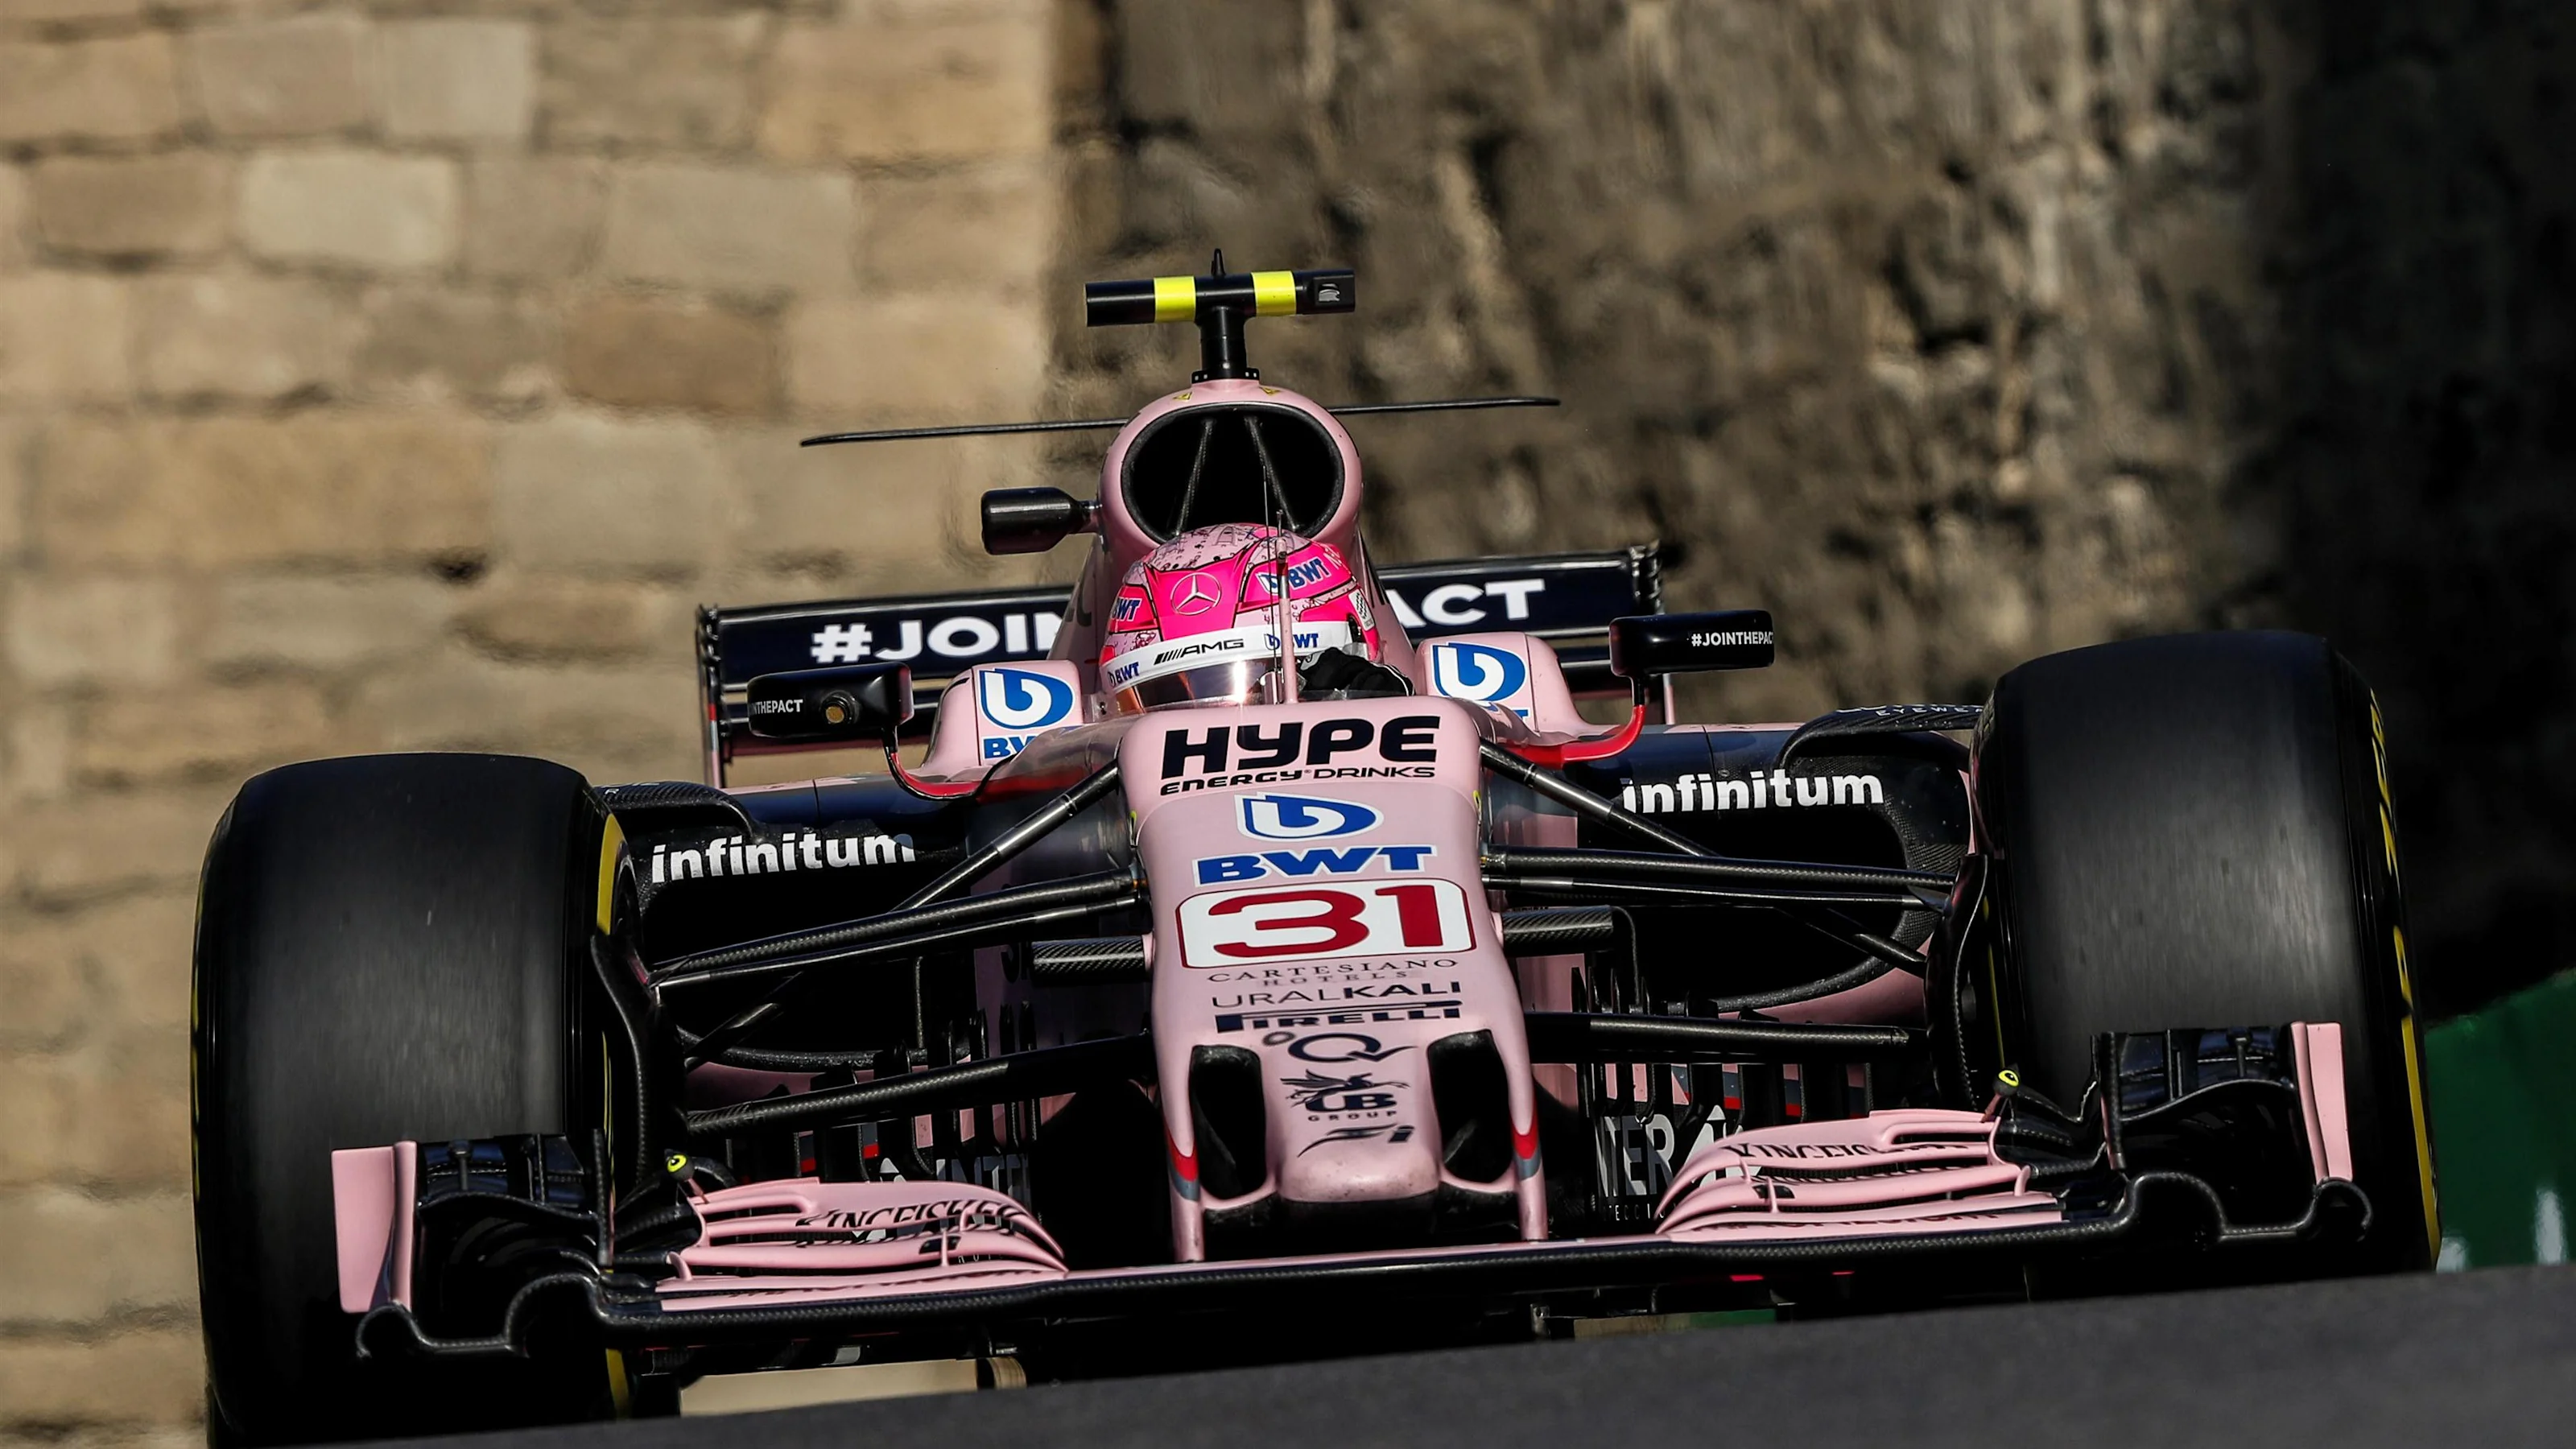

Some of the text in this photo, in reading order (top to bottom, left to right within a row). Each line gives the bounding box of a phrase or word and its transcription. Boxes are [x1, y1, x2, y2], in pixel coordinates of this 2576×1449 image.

[1288, 557, 1330, 588] BWT
[1293, 633, 1319, 649] WT
[1691, 631, 1774, 646] #JOINTHEPAC
[1115, 662, 1140, 685] BWT
[1161, 716, 1440, 780] HYPE
[1619, 769, 1884, 814] infinitum
[652, 832, 916, 884] infinitum
[1199, 846, 1433, 886] BWT
[1208, 886, 1444, 958] 31
[1208, 958, 1459, 983] CARTESIANO
[1264, 971, 1408, 987] HOTELS
[1212, 980, 1462, 1009] URALKALI
[1215, 1000, 1463, 1034] PIRELLI
[1307, 1110, 1397, 1122] GROUP
